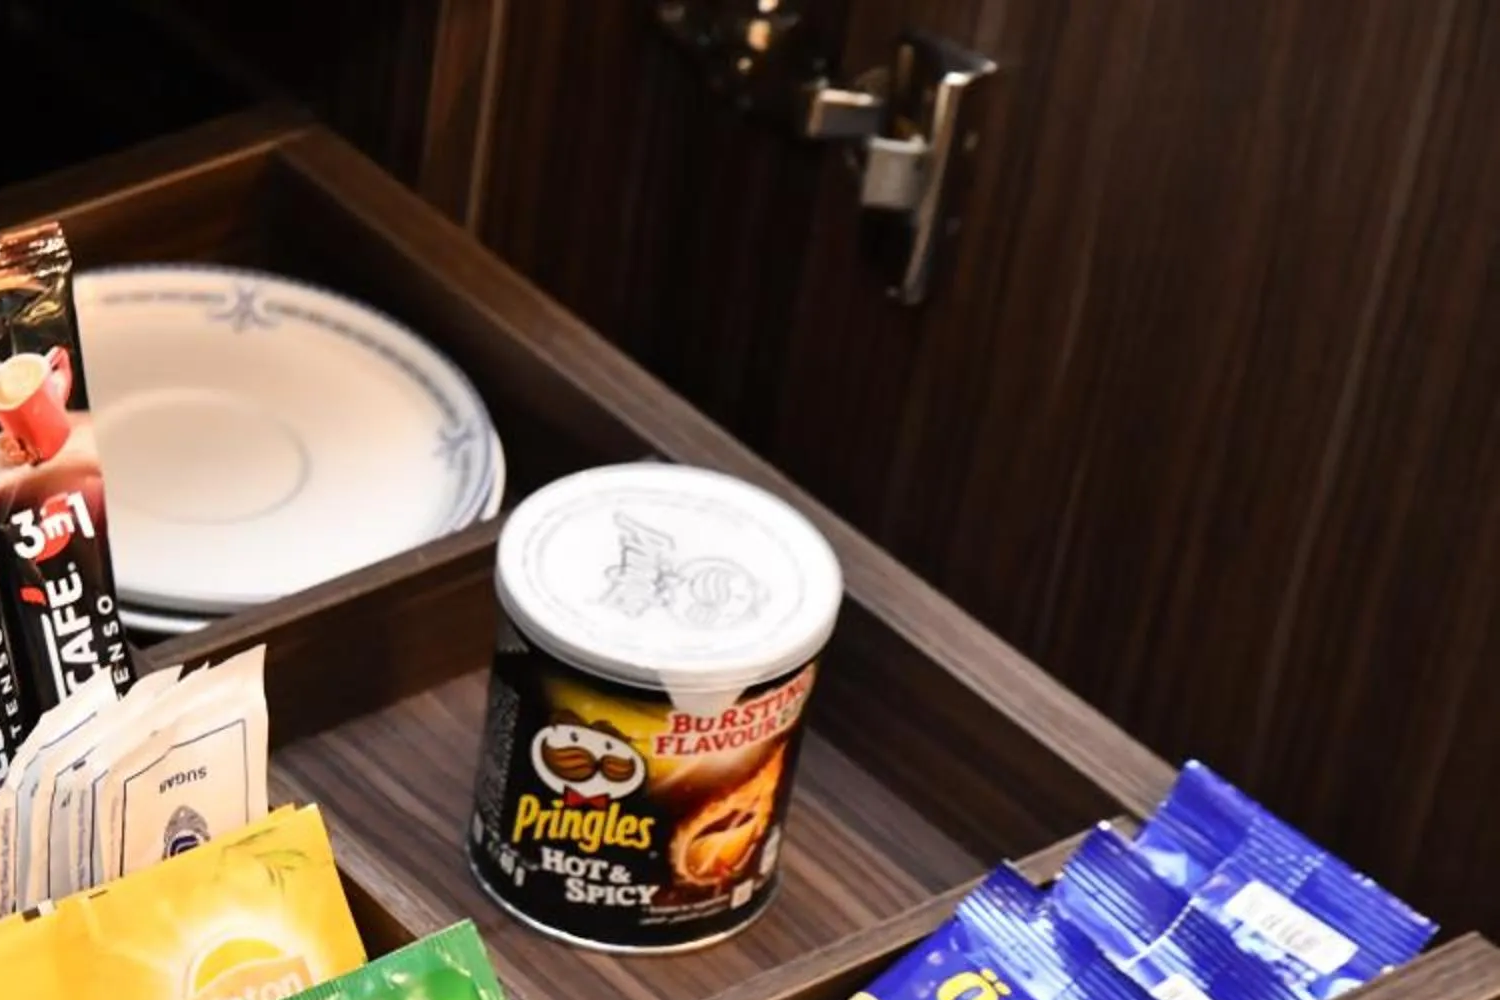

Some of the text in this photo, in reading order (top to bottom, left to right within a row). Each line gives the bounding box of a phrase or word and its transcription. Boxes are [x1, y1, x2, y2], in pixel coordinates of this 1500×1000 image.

[11, 491, 94, 559] 3in1
[97, 595, 130, 688] ENSO
[671, 678, 810, 734] BURSTIN
[655, 714, 778, 756] FLAVOUR
[159, 765, 208, 794] SUGAR
[512, 792, 656, 853] Pringles
[541, 847, 631, 884] HOT &
[565, 878, 660, 906] SPICY
